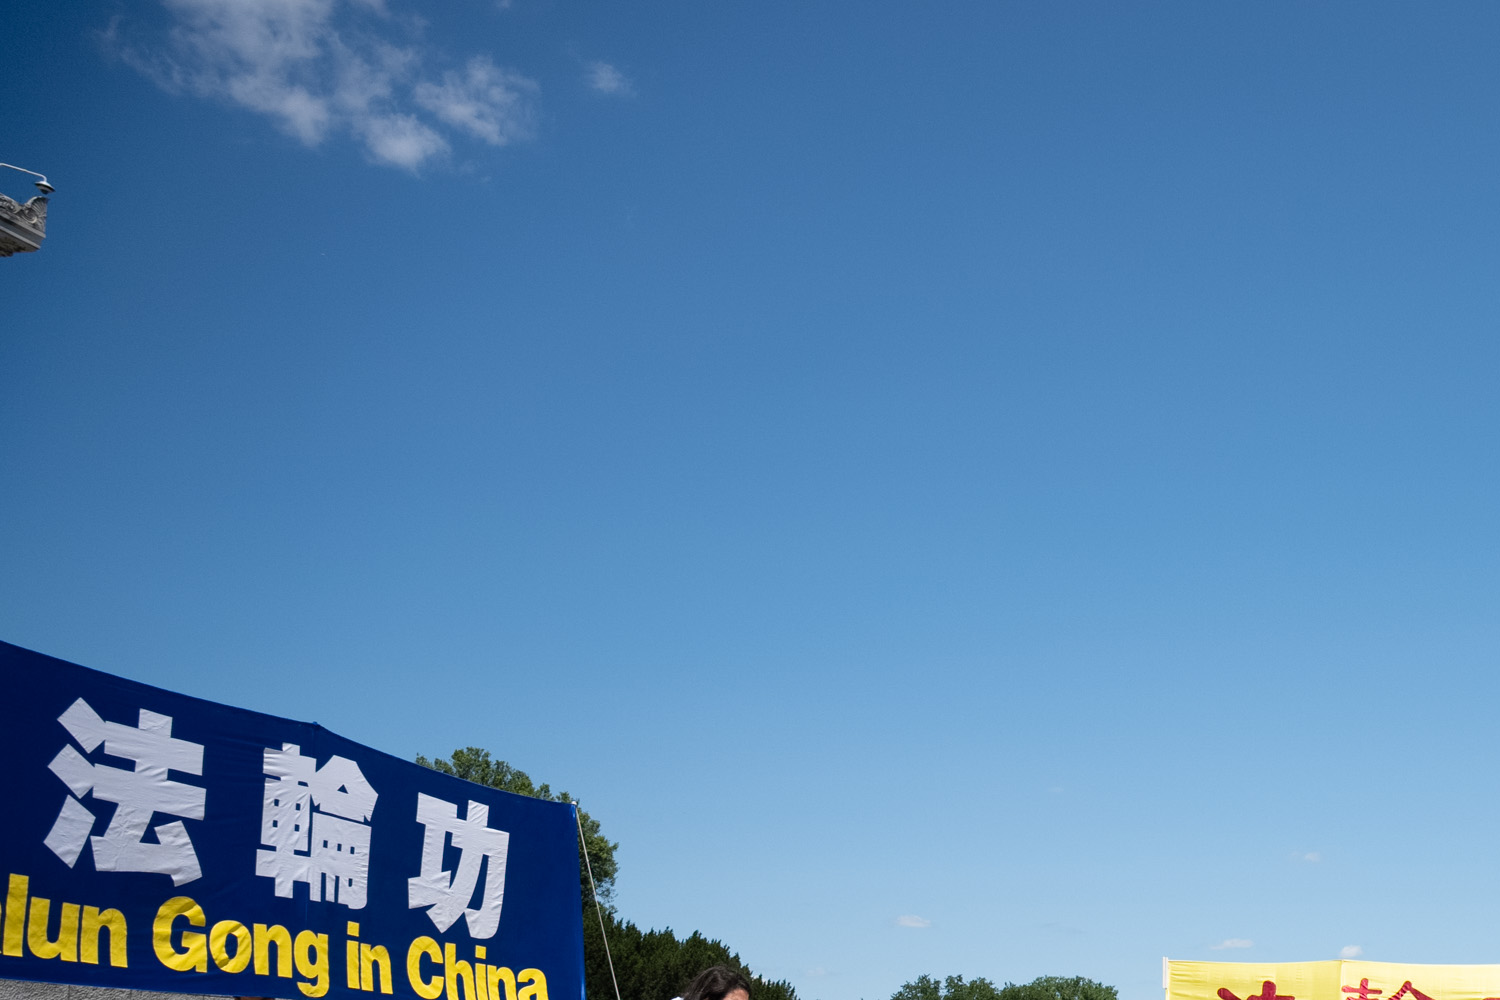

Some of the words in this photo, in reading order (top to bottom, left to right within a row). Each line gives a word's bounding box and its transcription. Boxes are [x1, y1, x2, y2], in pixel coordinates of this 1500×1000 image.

[43, 696, 510, 939] 法輪功
[0, 872, 128, 968] lun
[152, 896, 330, 998] Gong
[346, 920, 393, 995] in
